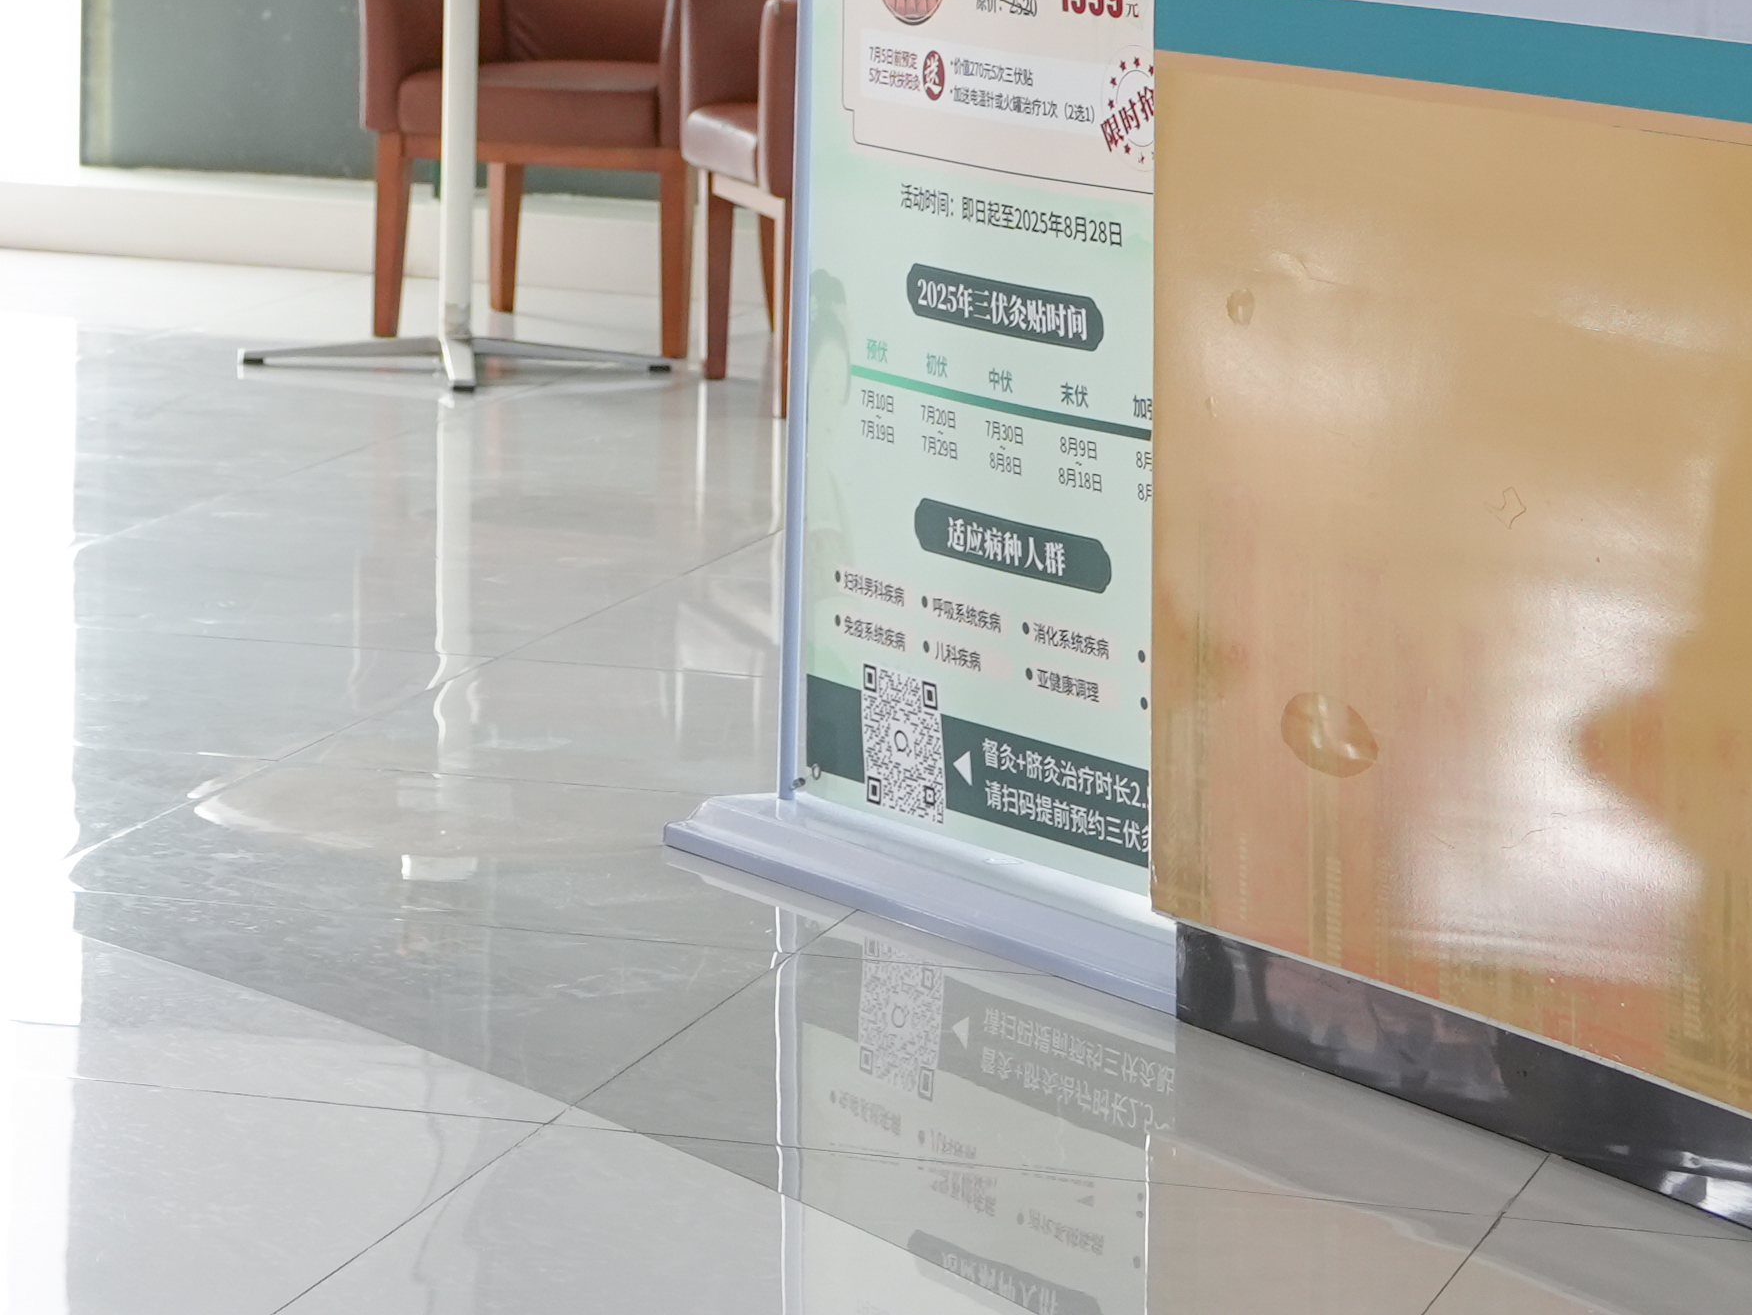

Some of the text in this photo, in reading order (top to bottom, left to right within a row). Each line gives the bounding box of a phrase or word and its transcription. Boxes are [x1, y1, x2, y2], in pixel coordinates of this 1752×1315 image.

[917, 278, 1088, 341] 2025年三伏灸贴时间
[926, 352, 948, 378] 初伏
[988, 368, 1013, 393] 中伏
[1060, 382, 1089, 408] 末伏
[985, 420, 1024, 446] 7月30日
[1060, 436, 1098, 460] 8月9日
[989, 452, 1022, 476] 8月8日
[1058, 468, 1103, 493] 8月18日
[947, 517, 1066, 576] 适应病种人群
[933, 596, 1001, 633] 呼吸系统疾病
[1033, 622, 1110, 660] 消化系统疾病
[934, 640, 981, 671] 儿科疾病
[1036, 668, 1100, 703] 亚健康调理
